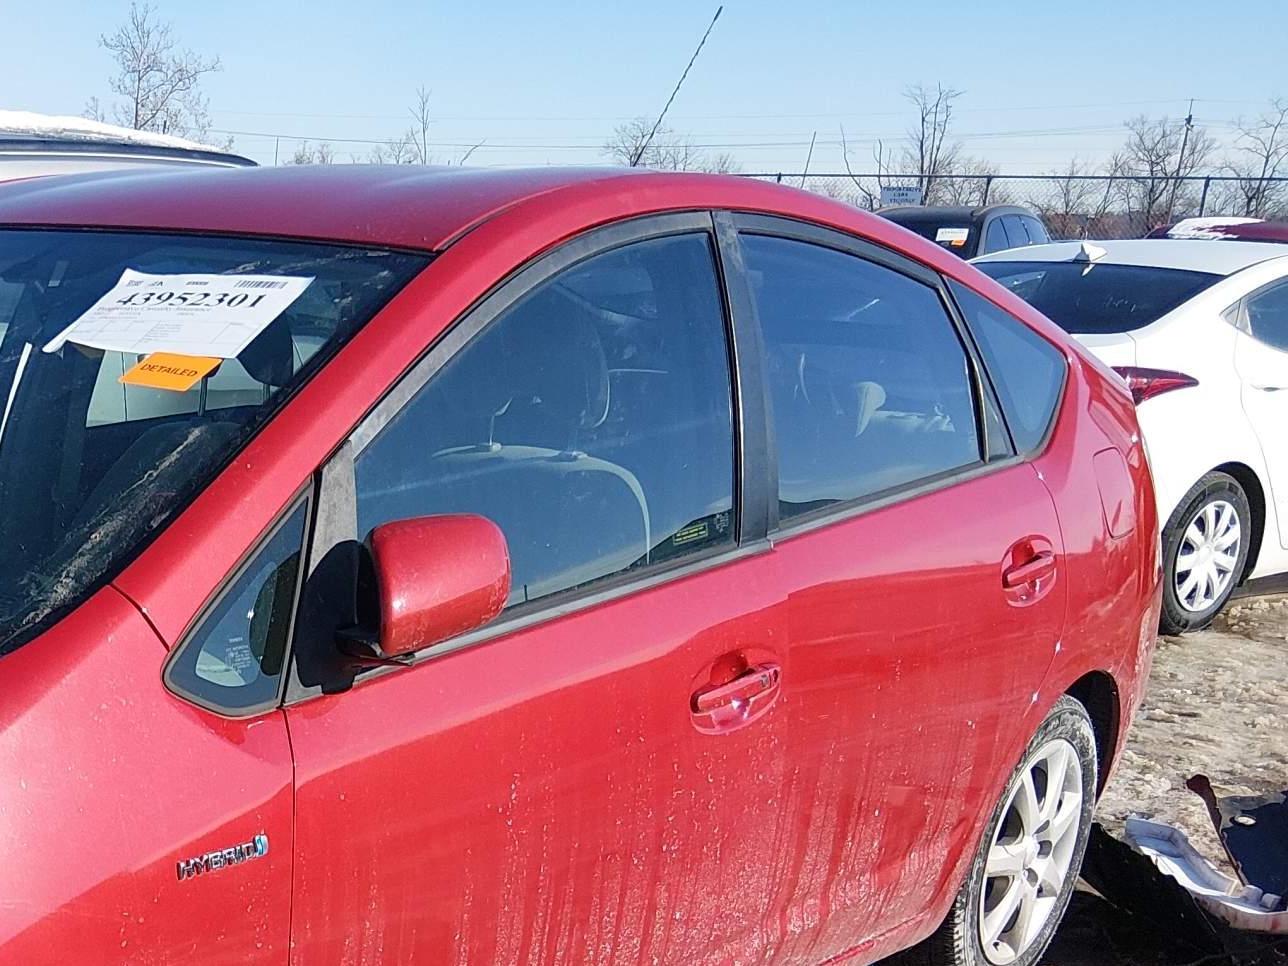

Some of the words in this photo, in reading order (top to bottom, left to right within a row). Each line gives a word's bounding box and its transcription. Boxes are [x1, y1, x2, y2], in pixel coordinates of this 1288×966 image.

[116, 291, 266, 308] 43952301
[140, 363, 198, 376] DETAILED
[176, 842, 255, 880] HYBRID
